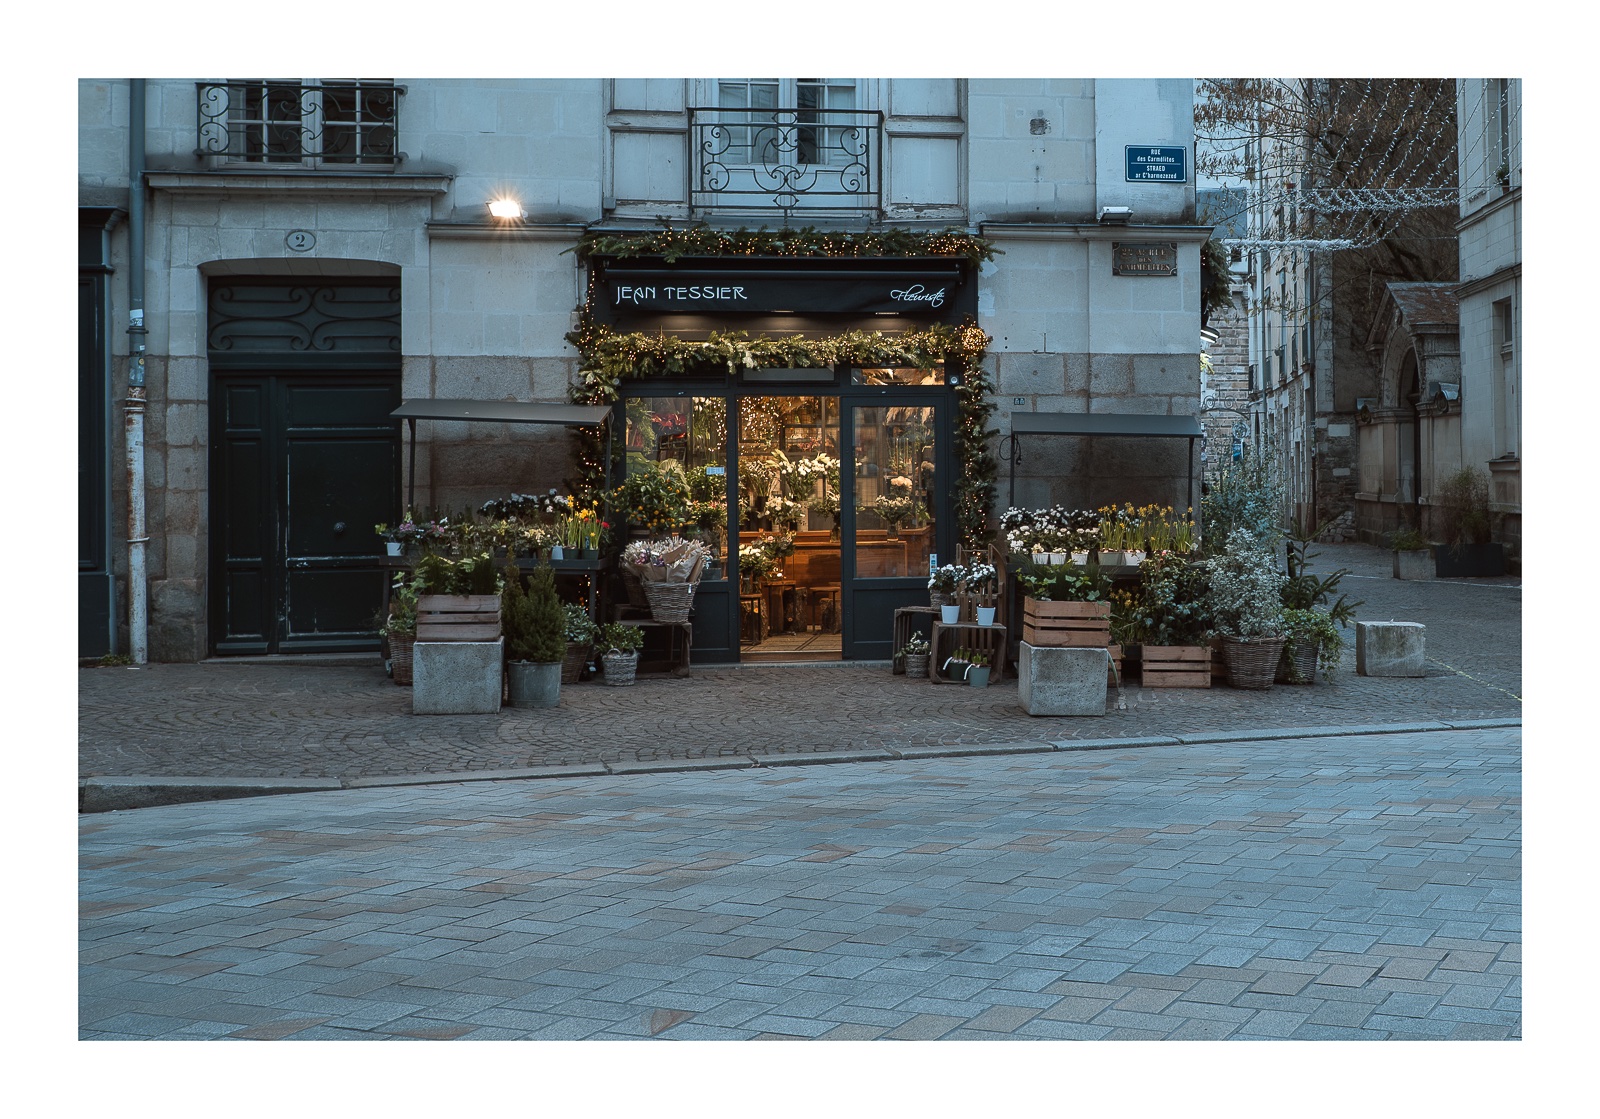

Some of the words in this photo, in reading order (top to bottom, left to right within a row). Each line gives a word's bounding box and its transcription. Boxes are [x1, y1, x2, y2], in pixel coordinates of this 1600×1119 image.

[296, 234, 305, 247] 2
[616, 286, 656, 304] JEAN
[664, 286, 747, 300] TESSIER
[890, 284, 945, 308] Fleuriste
